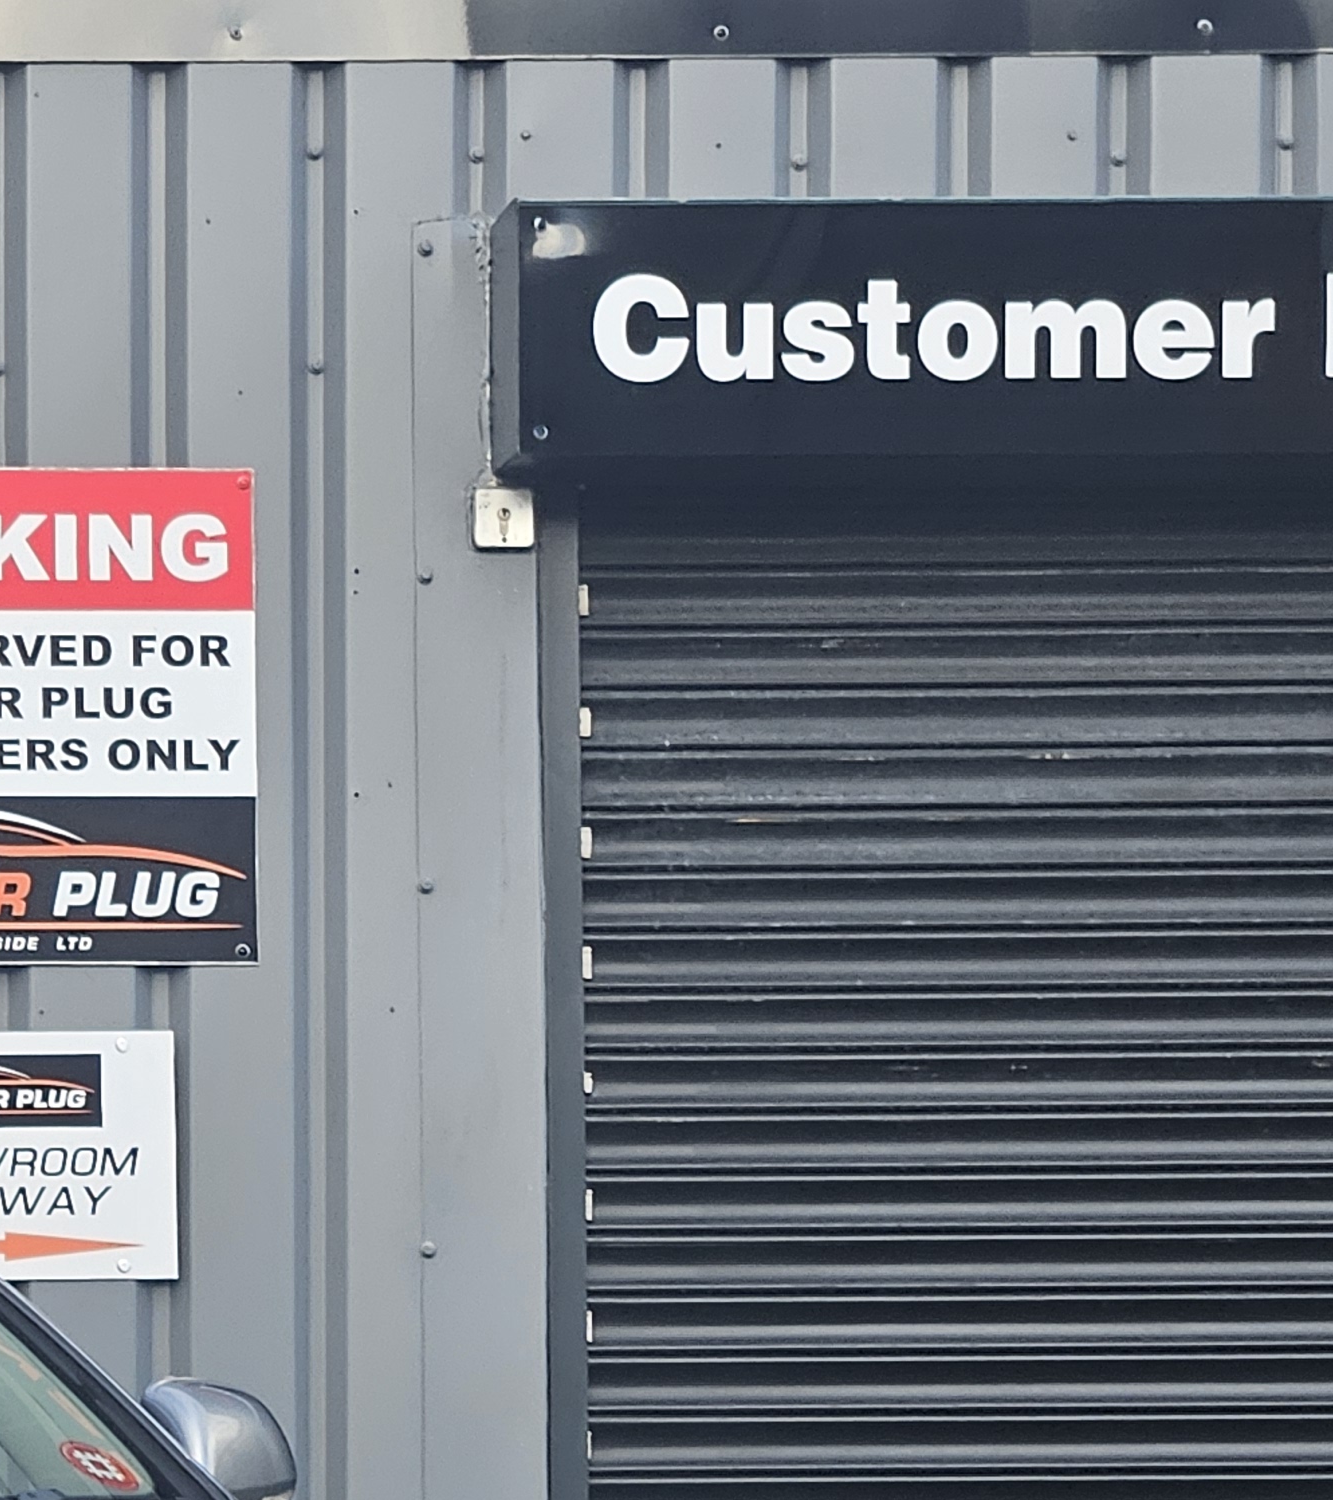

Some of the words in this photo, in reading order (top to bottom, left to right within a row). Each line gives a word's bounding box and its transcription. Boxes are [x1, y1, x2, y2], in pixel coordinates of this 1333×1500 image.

[592, 273, 1276, 382] Customer
[132, 634, 231, 667] FOR
[41, 687, 172, 719] PLUG
[108, 738, 240, 771] ONLY
[52, 871, 220, 918] PLUG
[56, 936, 93, 951] LTD
[16, 1088, 87, 1110] PLUG
[0, 1186, 112, 1216] WAY
